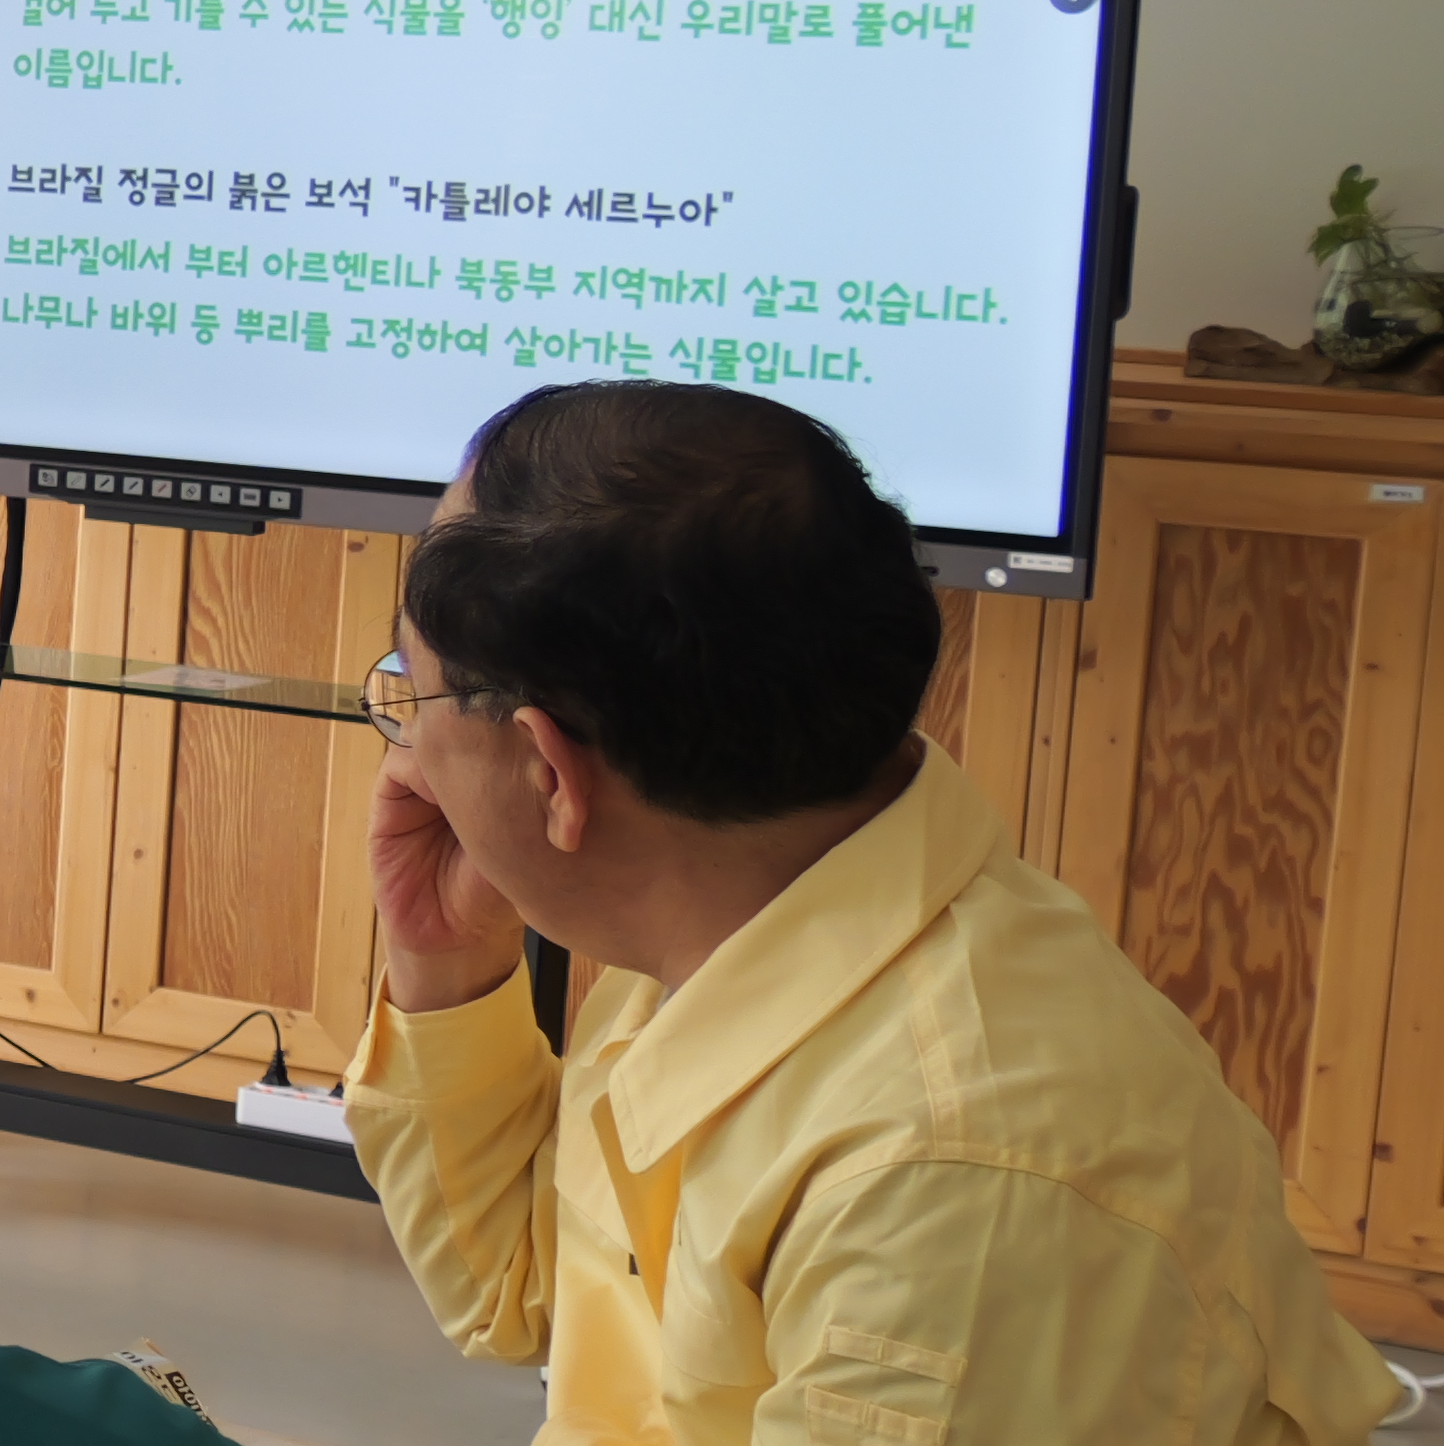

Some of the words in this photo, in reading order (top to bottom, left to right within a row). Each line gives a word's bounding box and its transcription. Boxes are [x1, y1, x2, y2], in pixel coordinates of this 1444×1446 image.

[681, 0, 834, 45] 우리말로
[852, 3, 974, 48] 풀어낸
[14, 48, 181, 89] 이름입니다.
[8, 163, 103, 203] 브라질
[118, 167, 214, 207] 정글의
[229, 171, 290, 213] 붉은
[305, 177, 371, 217] 보석
[5, 235, 170, 275] 브라질에서
[185, 244, 248, 278] 부터
[263, 248, 441, 292] 아르헨티나
[455, 258, 556, 303] 북동부
[573, 266, 726, 309] 지역까지
[743, 275, 819, 318] 살고
[838, 281, 1007, 326] 있습니다.
[3, 293, 98, 329] 나무나
[111, 300, 176, 337] 바위
[191, 305, 220, 345] 등
[235, 309, 331, 352] 뿌리를
[346, 318, 488, 359] 고정하여
[504, 326, 652, 376] 살아가는
[669, 337, 872, 384] 식물입니다.
